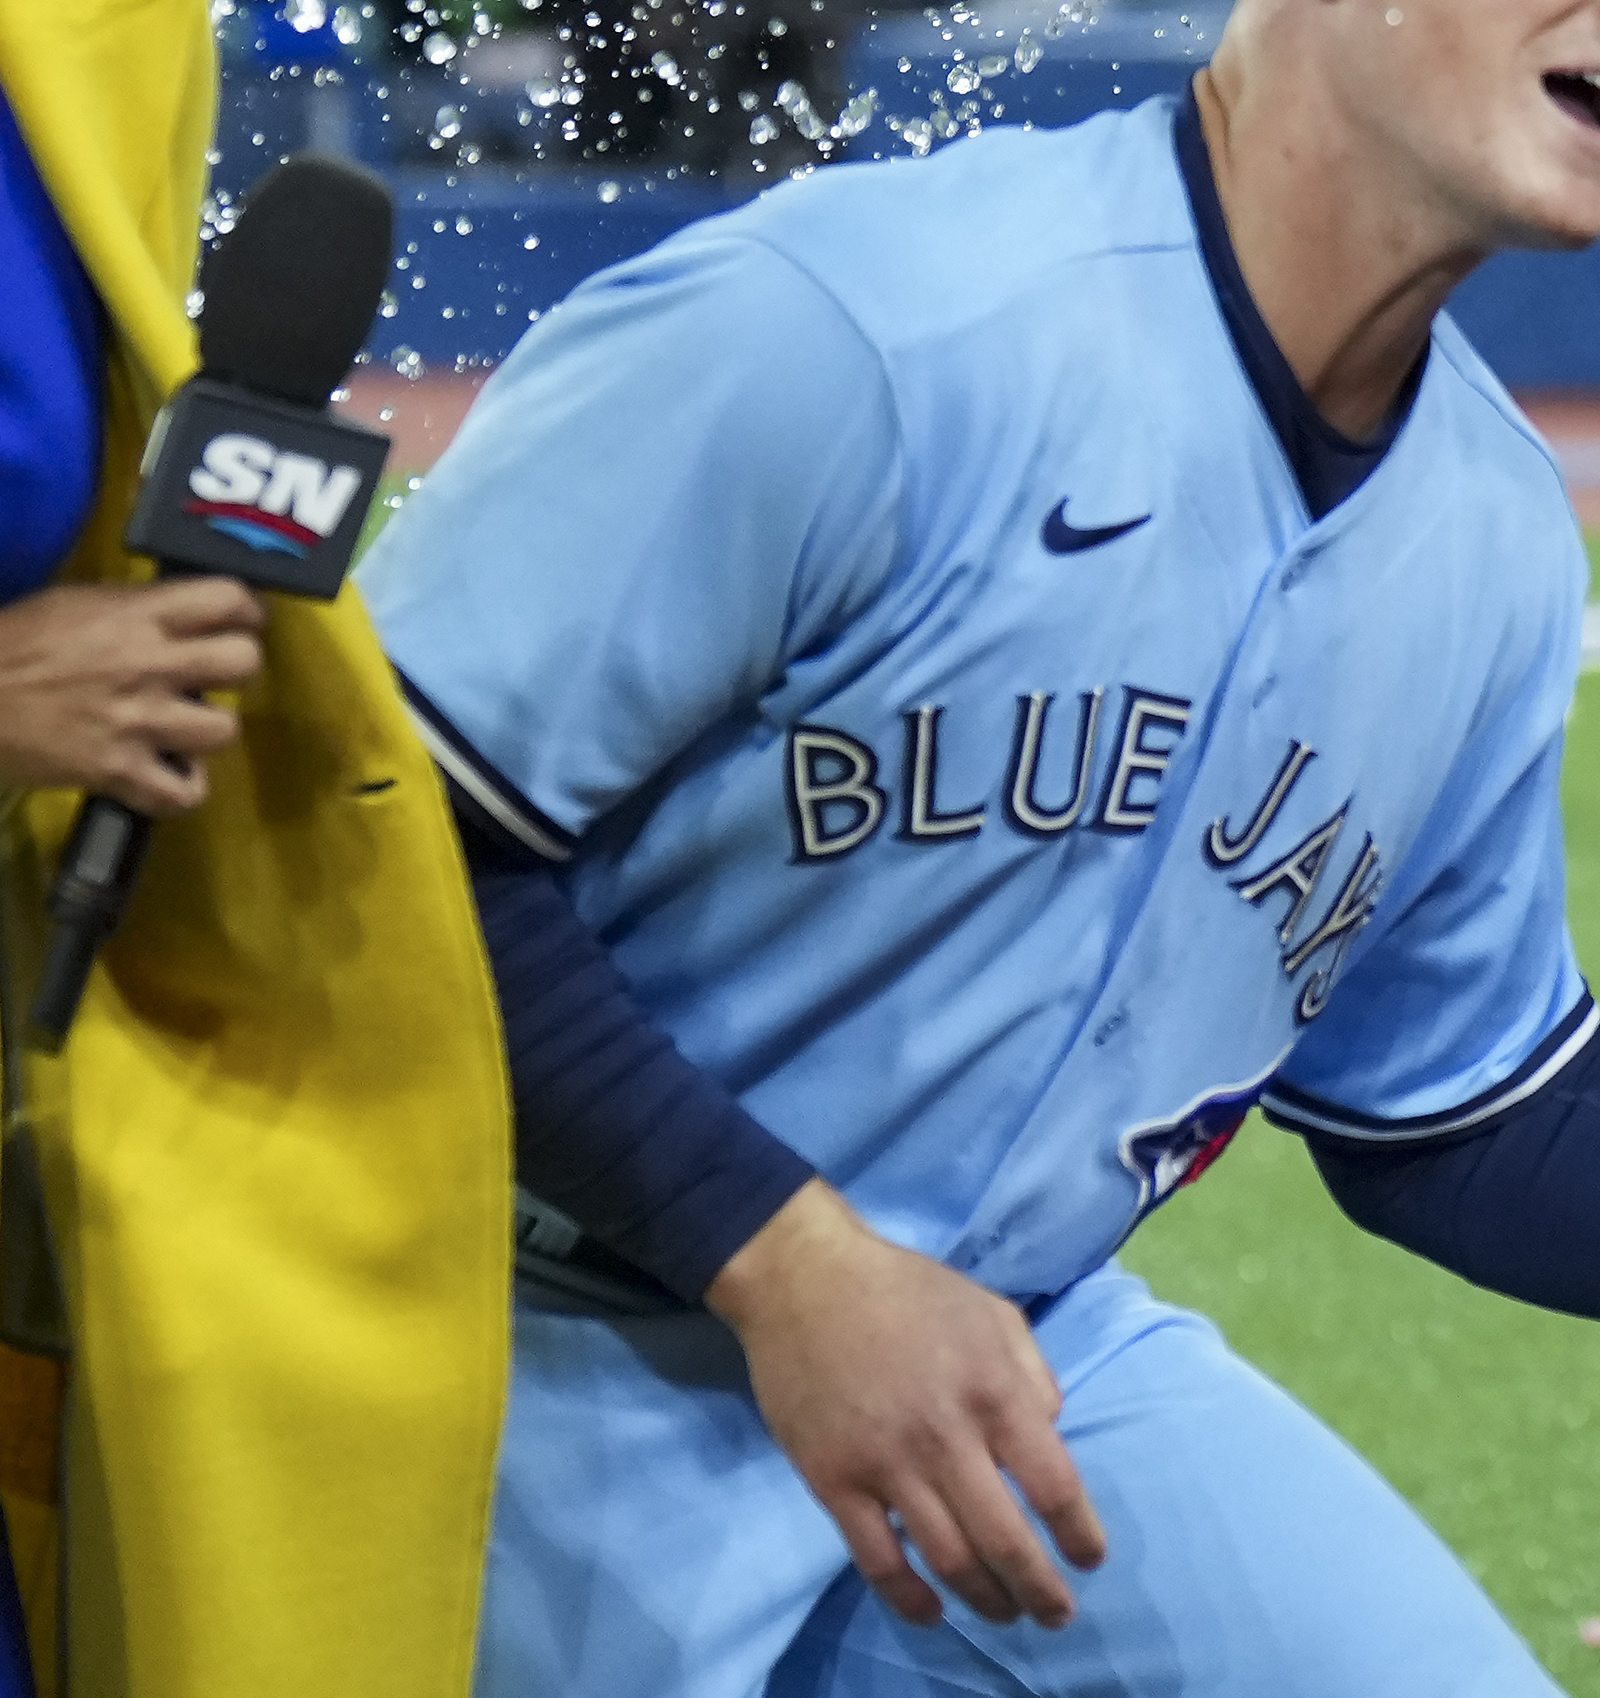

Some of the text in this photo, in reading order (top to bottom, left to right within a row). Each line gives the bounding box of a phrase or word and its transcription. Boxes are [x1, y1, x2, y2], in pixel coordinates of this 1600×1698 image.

[189, 433, 363, 539] SN
[784, 684, 1384, 1029] BLUE JAYS
